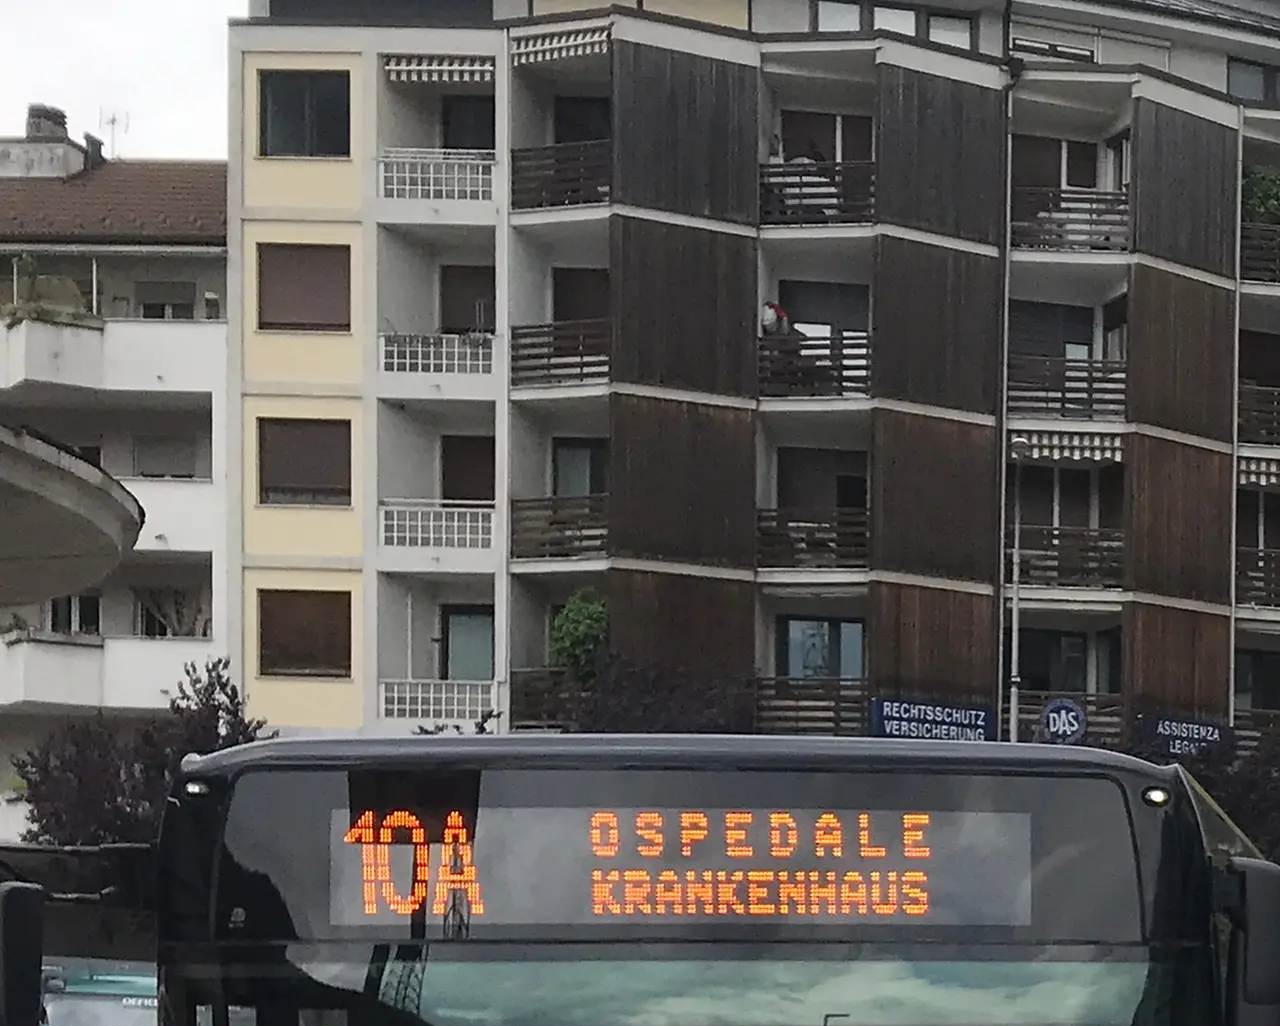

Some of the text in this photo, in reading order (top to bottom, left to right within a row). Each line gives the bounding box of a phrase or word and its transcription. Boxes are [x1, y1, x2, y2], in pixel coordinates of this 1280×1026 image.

[883, 702, 985, 726] RECHTSSCHUTZ
[1049, 710, 1078, 735] DAS
[884, 720, 985, 742] VERSICHERUNG
[1157, 720, 1220, 741] ASSISTENZA
[1170, 740, 1207, 754] LEGA
[590, 812, 931, 857] OSPEDALE
[344, 811, 484, 914] 10A
[592, 871, 929, 915] KRANKENHAUS
